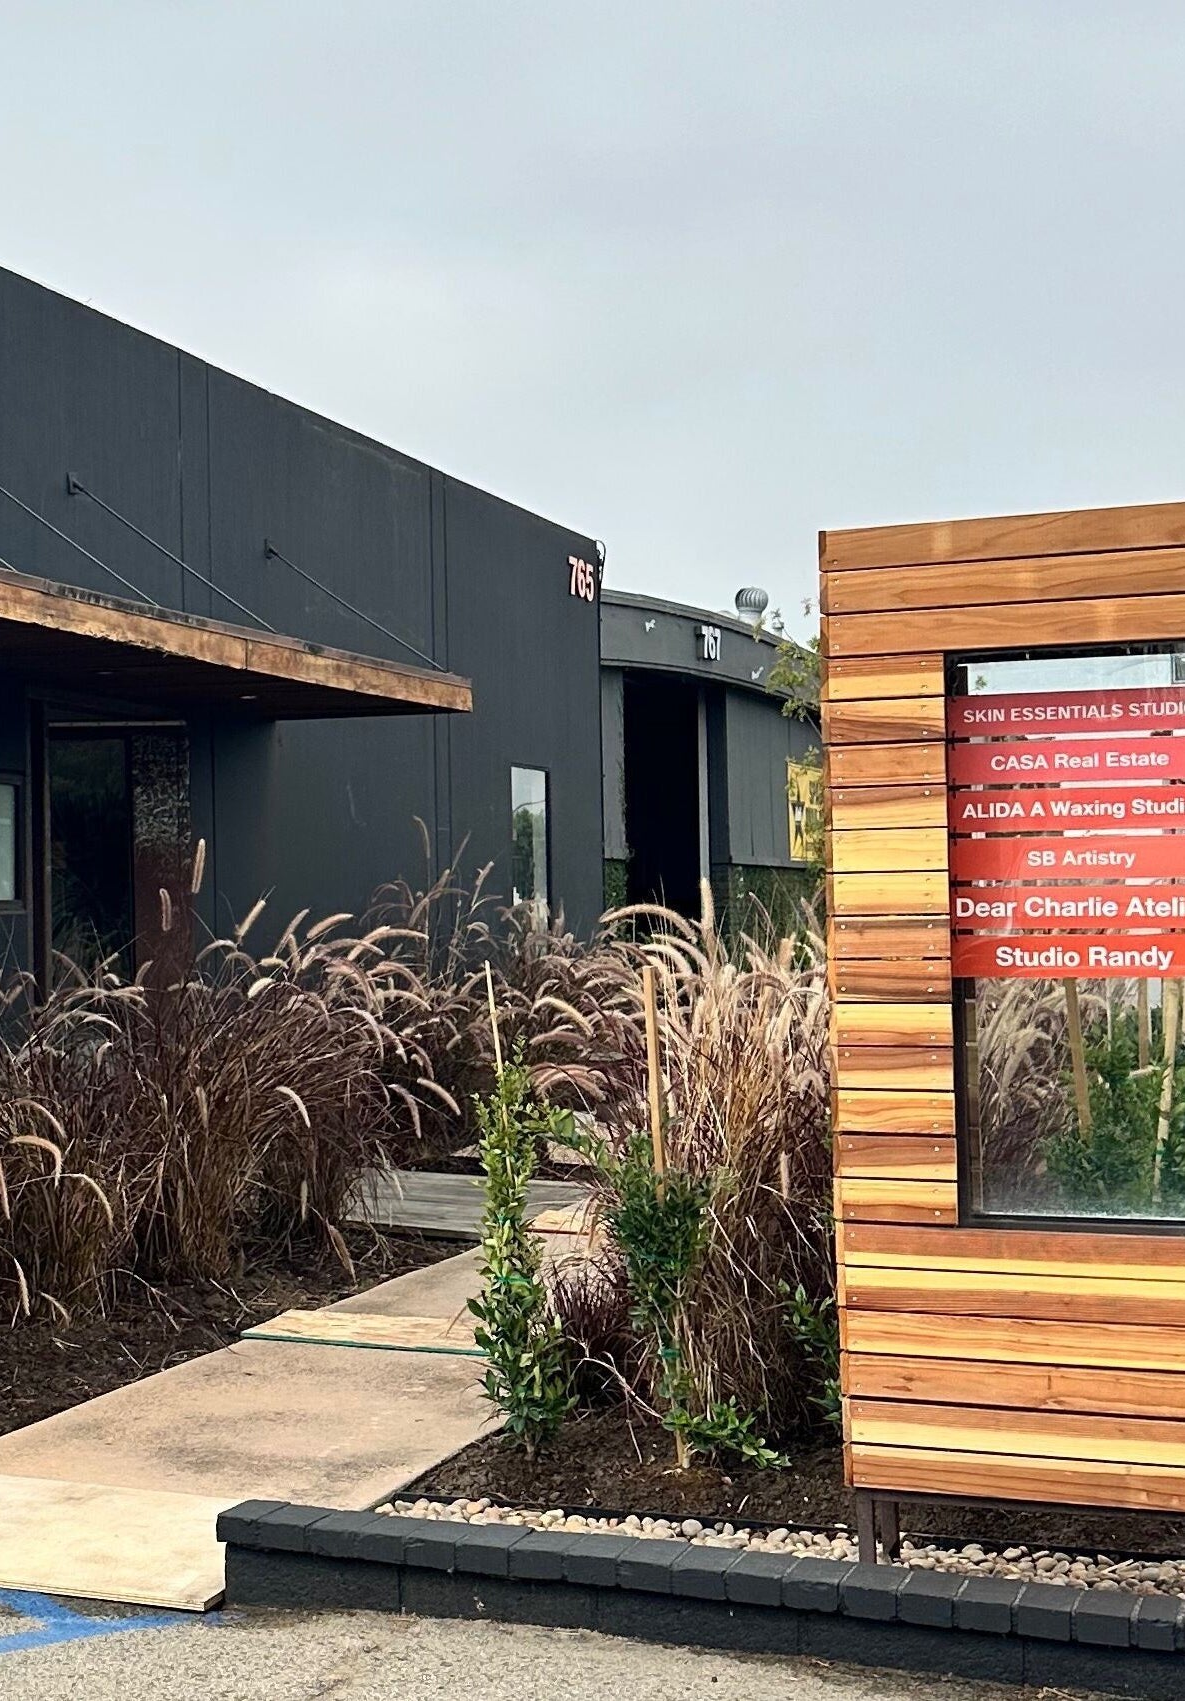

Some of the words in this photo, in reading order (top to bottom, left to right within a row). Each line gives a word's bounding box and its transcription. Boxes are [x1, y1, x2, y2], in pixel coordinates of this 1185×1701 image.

[568, 555, 595, 602] 765
[701, 625, 721, 661] 767
[963, 708, 1005, 723] SKIN
[1010, 704, 1124, 722] ESSENTIALS
[1128, 701, 1185, 717] STUDI
[990, 755, 1049, 771] CASA
[1054, 752, 1099, 769] Real
[1105, 752, 1170, 767] Estate
[962, 803, 1025, 819] ALIDA
[1029, 801, 1046, 817] A
[1050, 800, 1126, 818] Waxing
[1027, 851, 1056, 867] SB
[1062, 850, 1136, 868] Artistry
[956, 898, 1017, 917] Dear
[1024, 896, 1118, 917] Charlie
[996, 946, 1081, 967] Studio
[1088, 946, 1174, 971] Randy
